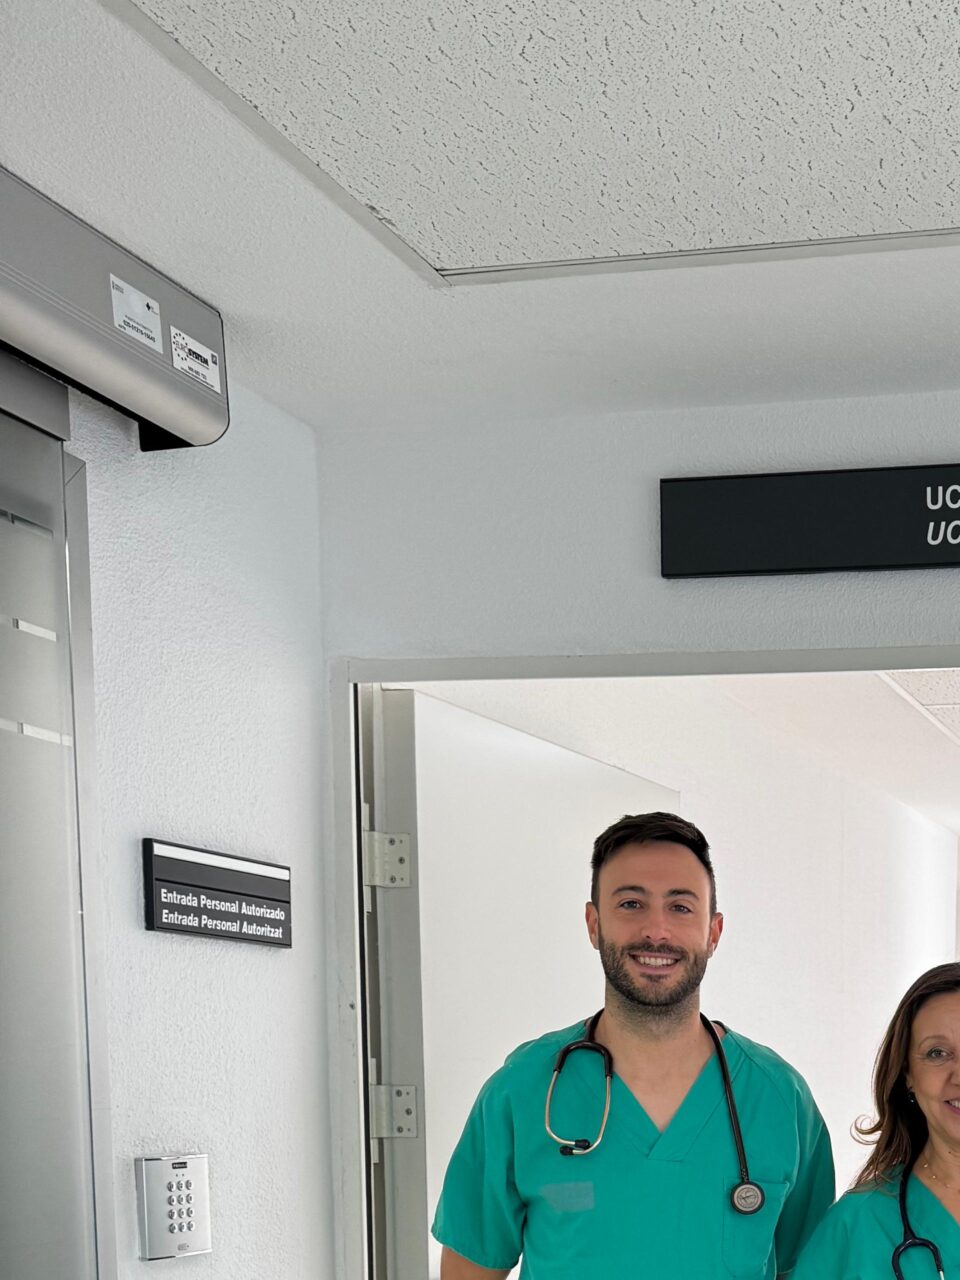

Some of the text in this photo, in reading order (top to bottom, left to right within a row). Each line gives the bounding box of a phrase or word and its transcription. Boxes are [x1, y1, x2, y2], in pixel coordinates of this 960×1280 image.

[160, 888, 285, 920] Entrada Personal Autorizado
[162, 909, 283, 939] Entrada Personal Autoritzat
